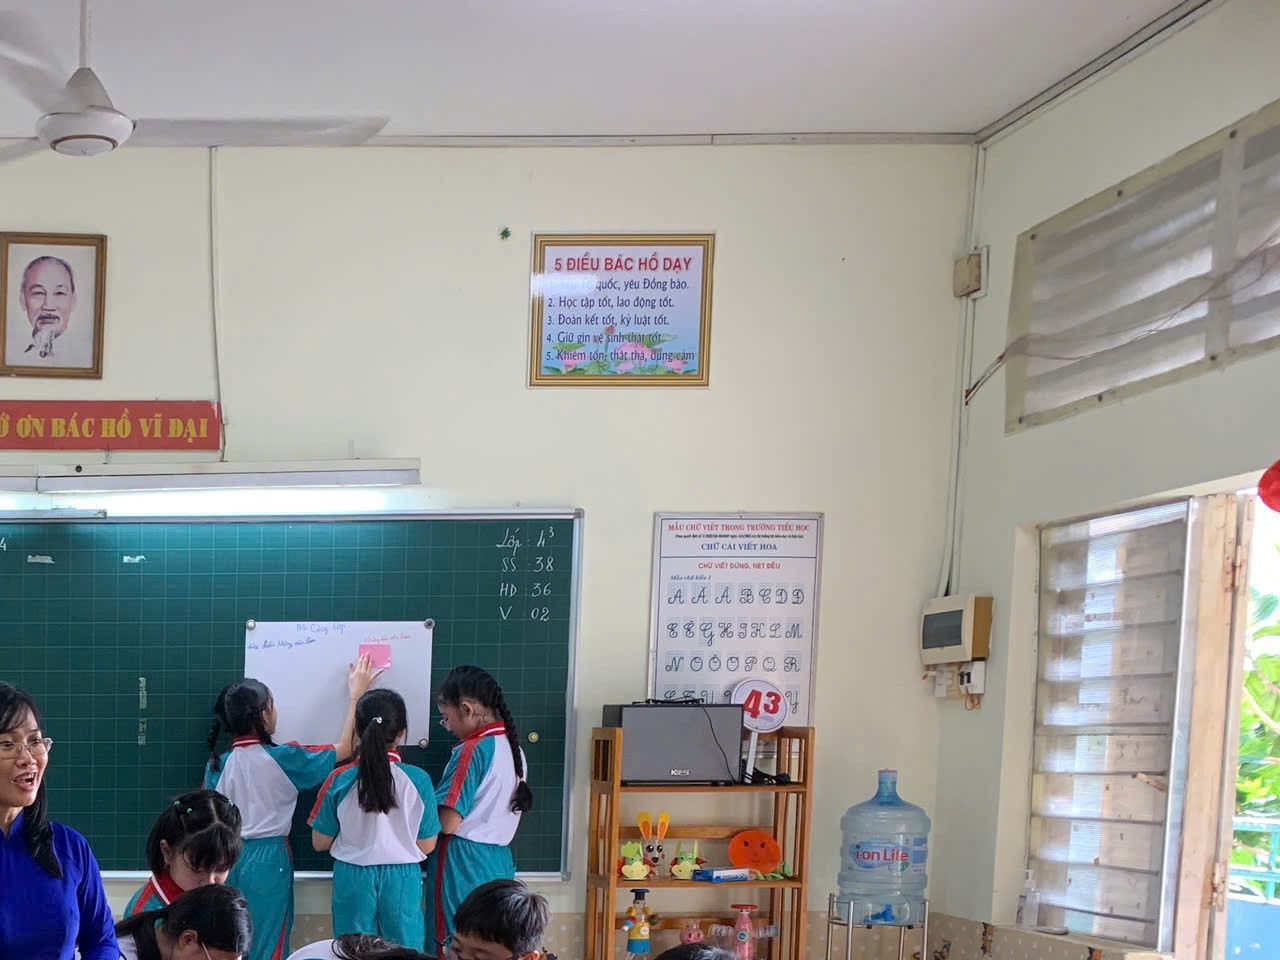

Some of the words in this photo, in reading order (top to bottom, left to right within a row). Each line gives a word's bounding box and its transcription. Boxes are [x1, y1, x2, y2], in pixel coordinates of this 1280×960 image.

[554, 258, 562, 271] 5
[566, 251, 600, 271] ĐIỀU
[604, 253, 634, 271] BÁC
[638, 251, 659, 271] HỒ
[663, 257, 692, 274] DẠY
[624, 279, 640, 290] yêu
[643, 278, 667, 291] Đồng
[548, 298, 556, 307] 2.
[559, 296, 578, 309] Học
[580, 296, 595, 310] tập
[598, 296, 614, 309] tốt,
[616, 296, 631, 307] lao
[633, 296, 657, 310] động
[659, 296, 675, 307] tốt.
[547, 316, 555, 325] 3.
[558, 314, 582, 325] Đoàn
[585, 314, 599, 325] kết
[602, 314, 618, 326] tốt,
[634, 314, 651, 326] luật
[654, 314, 670, 325] tốt.
[546, 334, 554, 343] 4.
[557, 332, 574, 343] Giữ
[607, 332, 624, 343] sinh
[546, 351, 554, 361] 5.
[16, 414, 44, 437] ƠN
[50, 412, 96, 437] BÁC
[100, 408, 132, 437] HỒ
[140, 414, 163, 437] VĨ
[168, 417, 209, 443] ĐẠI
[686, 523, 701, 531] CHỮ
[703, 523, 719, 531] VIẾT
[746, 523, 775, 531] TRƯỜNG
[701, 542, 720, 551] CHỮ
[738, 542, 758, 551] VIẾT
[760, 543, 778, 551] HOA
[533, 556, 554, 573] 38
[531, 582, 552, 598] 36
[668, 588, 685, 604] A
[739, 588, 754, 604] B
[758, 588, 772, 604] C
[775, 588, 788, 604] D
[791, 588, 805, 604] Đ
[531, 606, 550, 622] 02
[666, 622, 678, 639] E
[699, 622, 716, 647] G
[718, 622, 734, 639] H
[750, 622, 766, 639] K
[769, 622, 782, 639] L
[785, 622, 803, 639] M
[665, 656, 684, 672] N
[690, 656, 703, 672] O
[708, 654, 721, 672] Ô
[744, 656, 757, 672] P
[763, 656, 776, 672] Q
[784, 656, 800, 672] R
[743, 688, 781, 719] 43
[883, 848, 909, 861] Life
